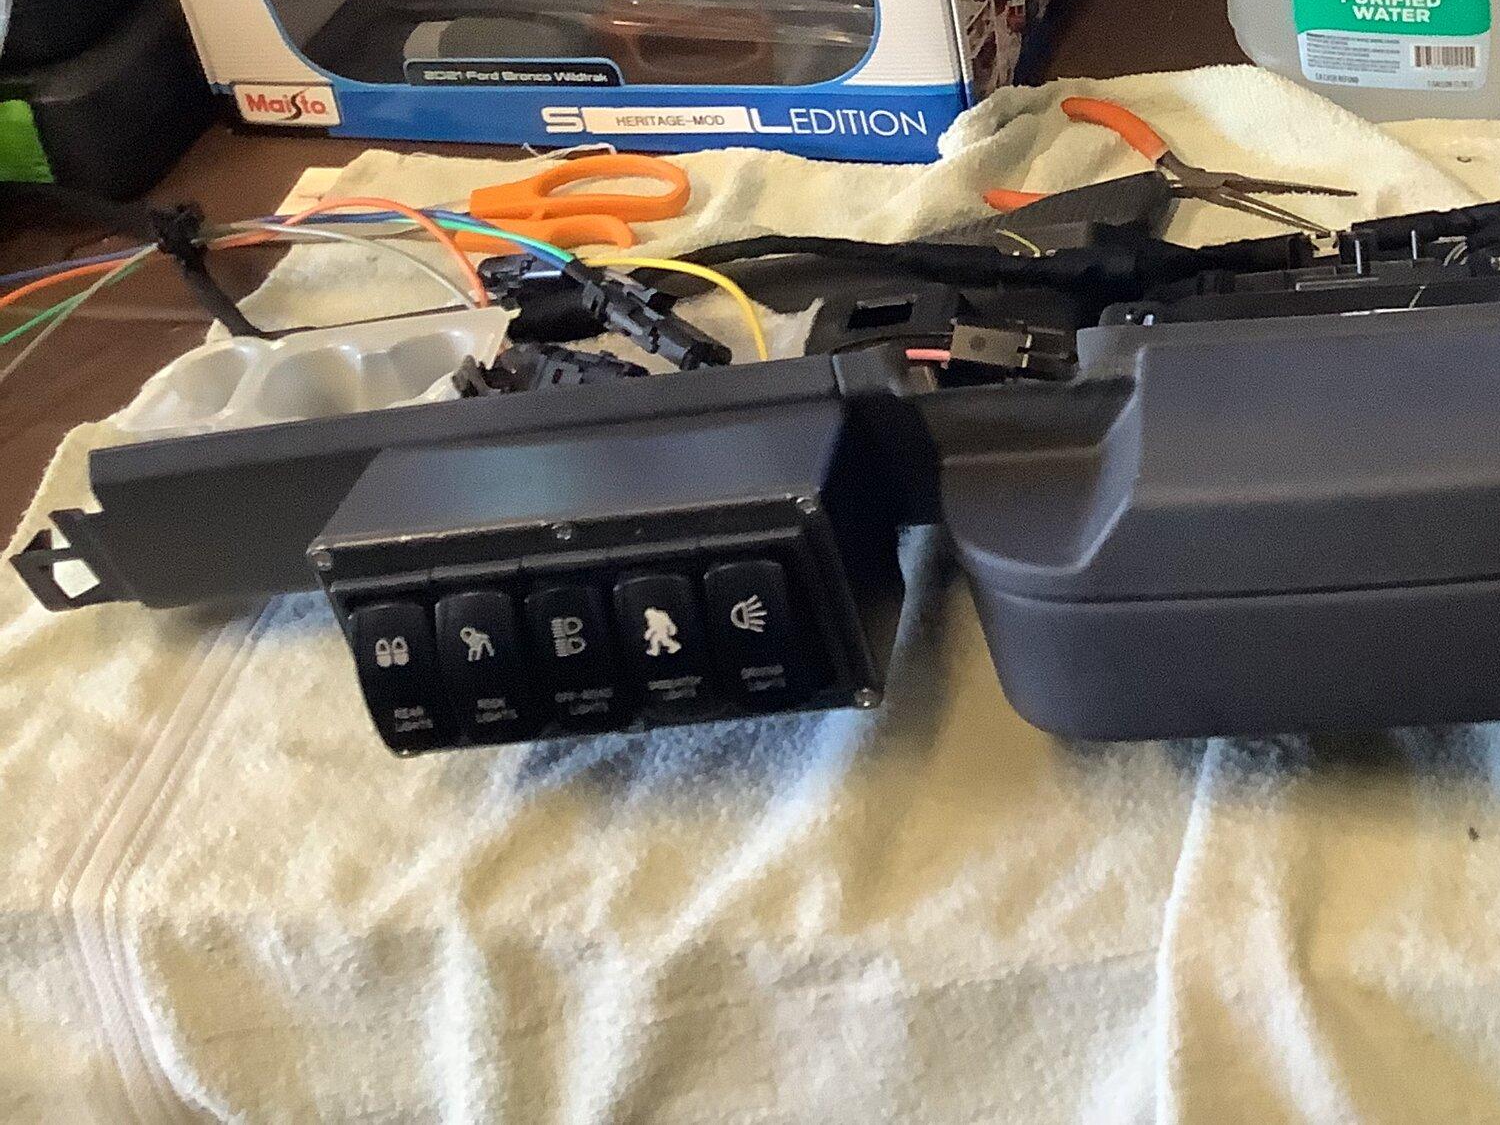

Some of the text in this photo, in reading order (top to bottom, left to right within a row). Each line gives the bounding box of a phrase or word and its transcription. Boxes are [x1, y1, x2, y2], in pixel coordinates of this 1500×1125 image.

[1352, 5, 1431, 23] WATER
[466, 70, 500, 81] Ford
[501, 70, 553, 82] Bronco
[554, 71, 609, 83] Wildtrak
[245, 86, 327, 120] Maisto
[616, 115, 726, 127] HERITAGE-MOD
